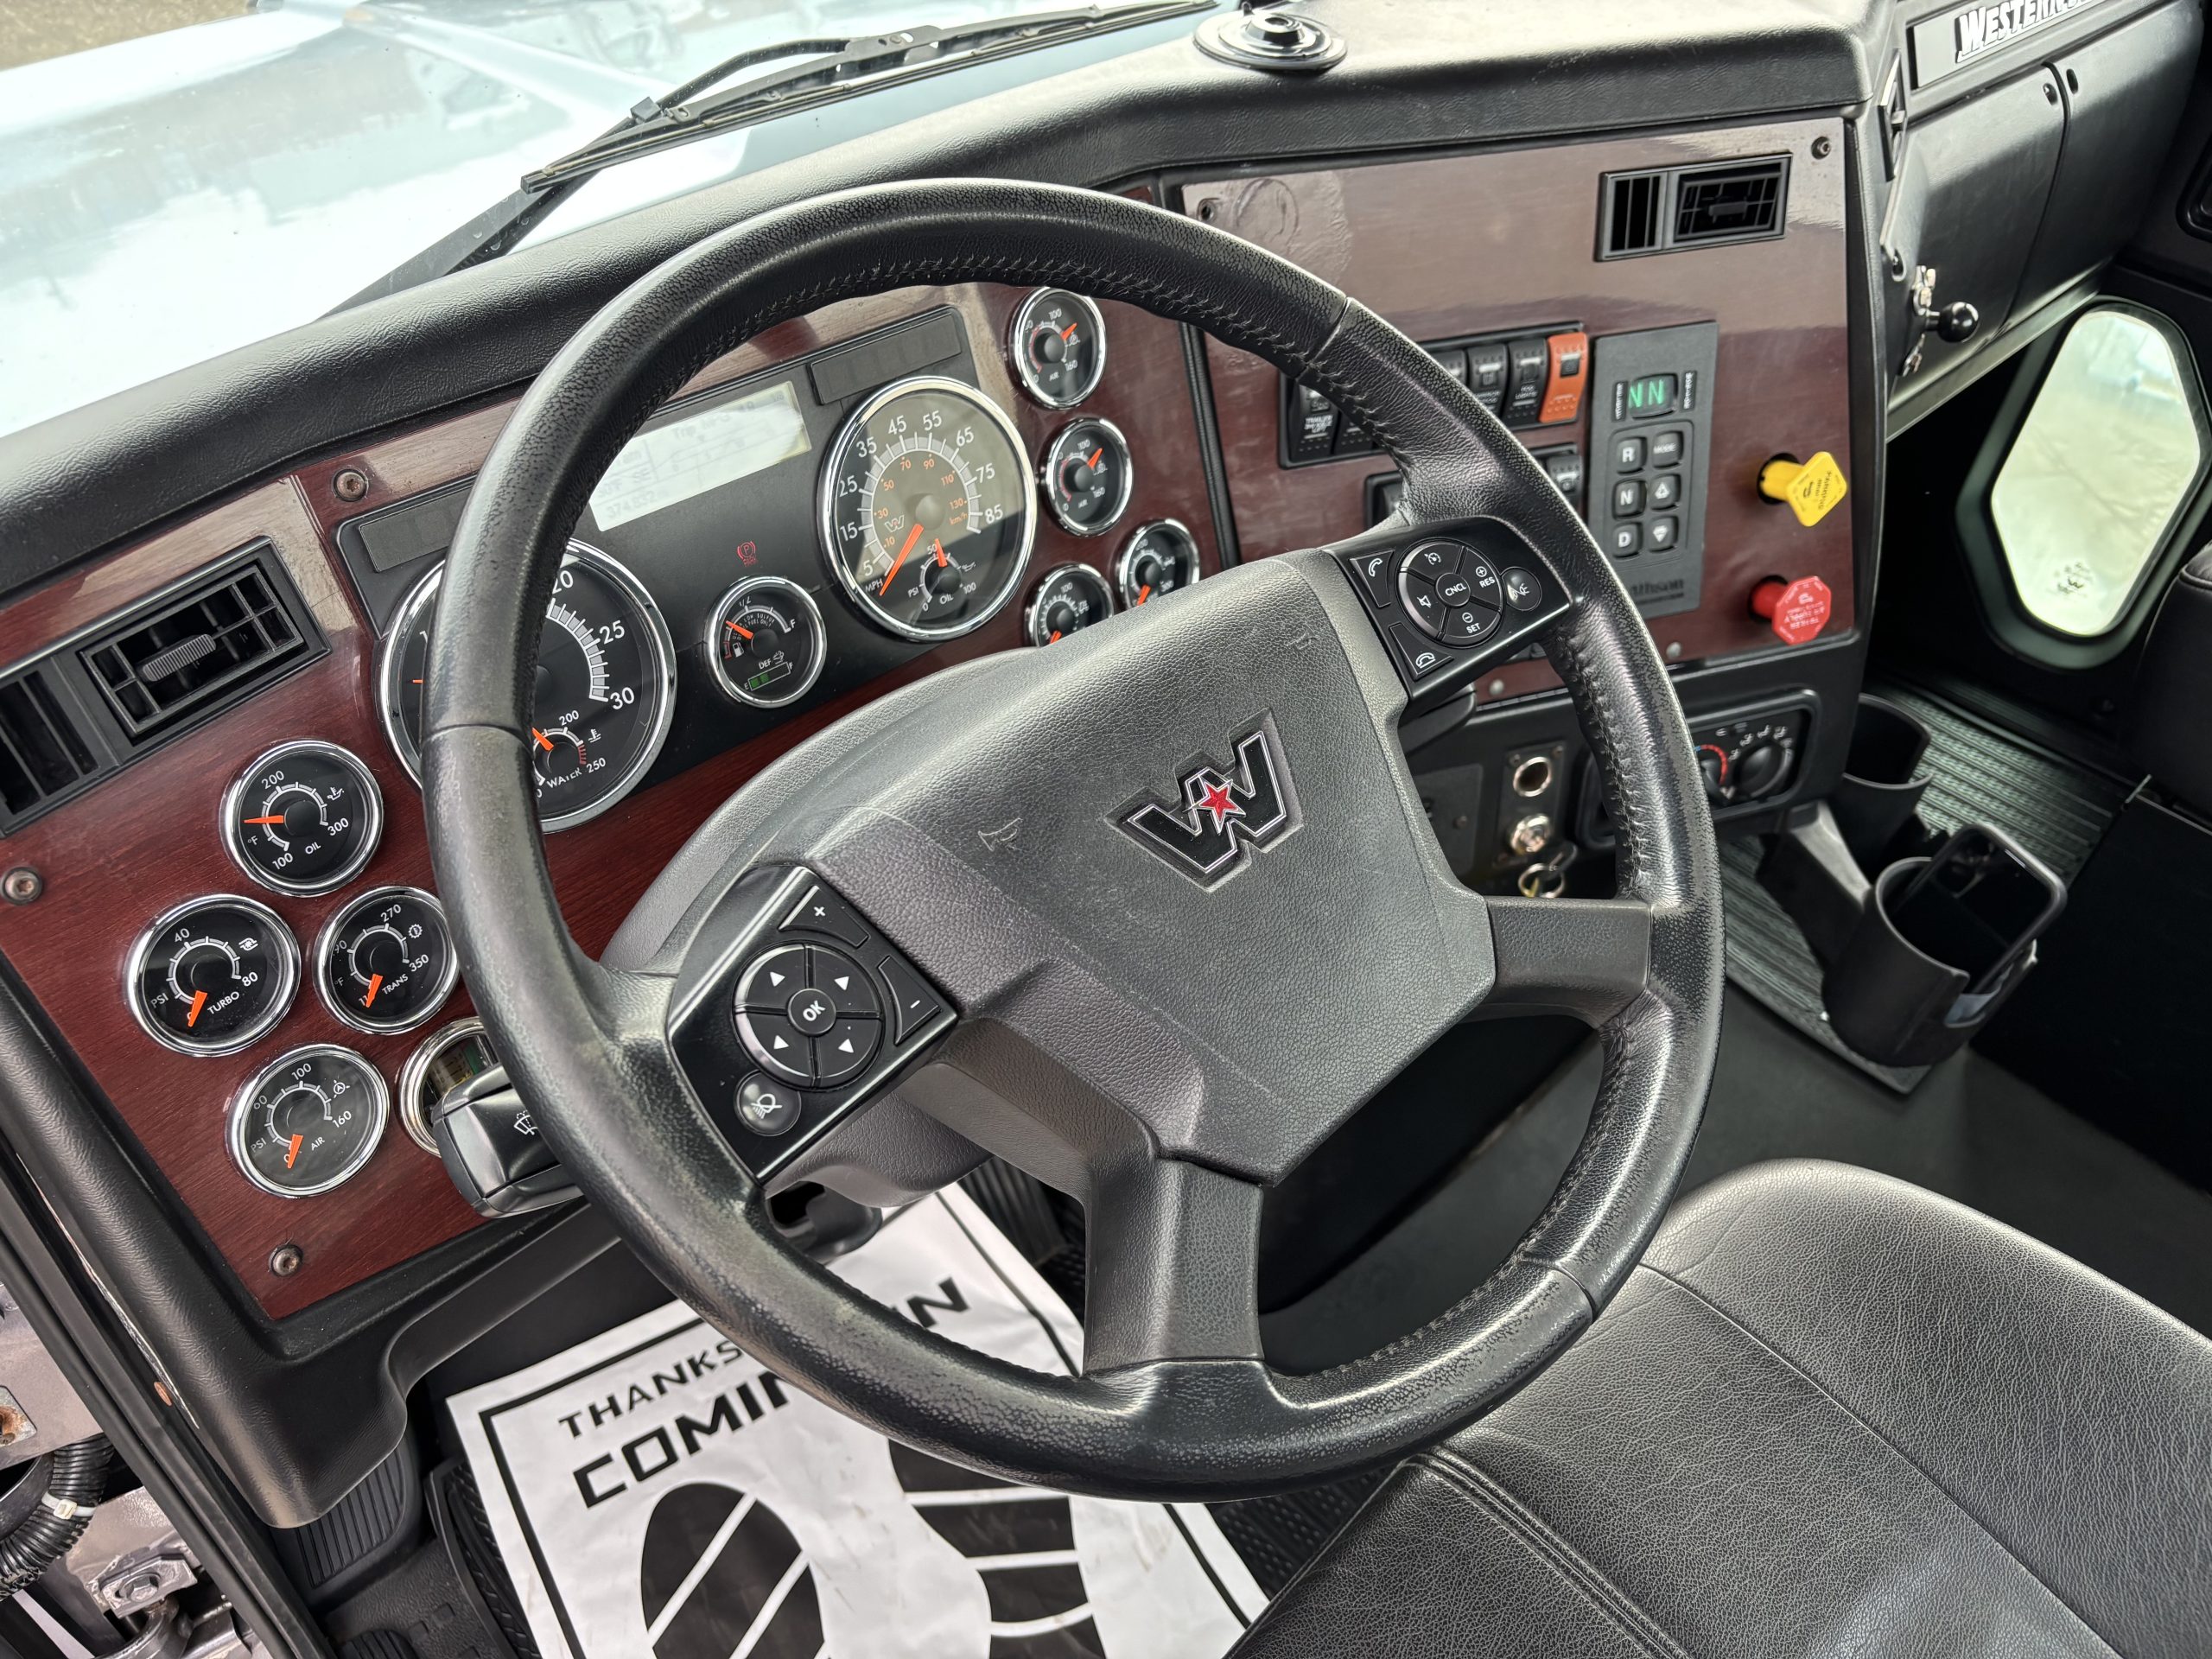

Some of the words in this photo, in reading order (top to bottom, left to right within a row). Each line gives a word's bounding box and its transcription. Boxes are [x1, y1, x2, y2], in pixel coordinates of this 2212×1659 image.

[887, 415, 907, 435] 45
[922, 410, 942, 431] 55
[956, 426, 974, 447] 65
[855, 436, 878, 458] 35
[1622, 447, 1635, 462] R
[899, 460, 912, 471] 70
[923, 459, 935, 470] 90
[976, 462, 995, 483] 75
[839, 475, 858, 498] 25
[883, 480, 895, 492] 50
[941, 474, 955, 486] 110
[950, 498, 963, 510] 130
[1620, 488, 1634, 505] N
[878, 507, 889, 519] 30
[984, 504, 1003, 524] 85
[840, 521, 858, 542] 15
[1618, 531, 1631, 548] D
[863, 560, 874, 576] 5
[865, 579, 883, 593] MPH
[963, 582, 976, 594] 100
[1445, 583, 1467, 597] CNCL
[1478, 576, 1496, 588] RES
[907, 587, 918, 598] PSI
[790, 619, 796, 628] F
[1466, 623, 1481, 633] SET
[599, 620, 625, 645] 25
[759, 658, 772, 670] DEF
[610, 687, 635, 710] 30
[558, 709, 580, 727] 200
[586, 757, 606, 773] 250
[261, 770, 284, 790] 200
[327, 817, 349, 836] 300
[305, 842, 321, 855] OIL
[271, 852, 294, 870] 100
[380, 904, 402, 922] 270
[174, 928, 190, 944] 40
[409, 954, 429, 972] 350
[241, 971, 258, 987] 80
[381, 973, 409, 995] TRANS
[150, 992, 169, 1008] PSI
[207, 991, 240, 1014] TURBO
[802, 999, 826, 1022] OK
[291, 1063, 312, 1080] 100
[333, 1110, 352, 1128] 160
[250, 1137, 267, 1154] PSI
[310, 1136, 325, 1151] AIR
[558, 1340, 743, 1438] THANKS
[573, 1370, 788, 1509] COMIN
